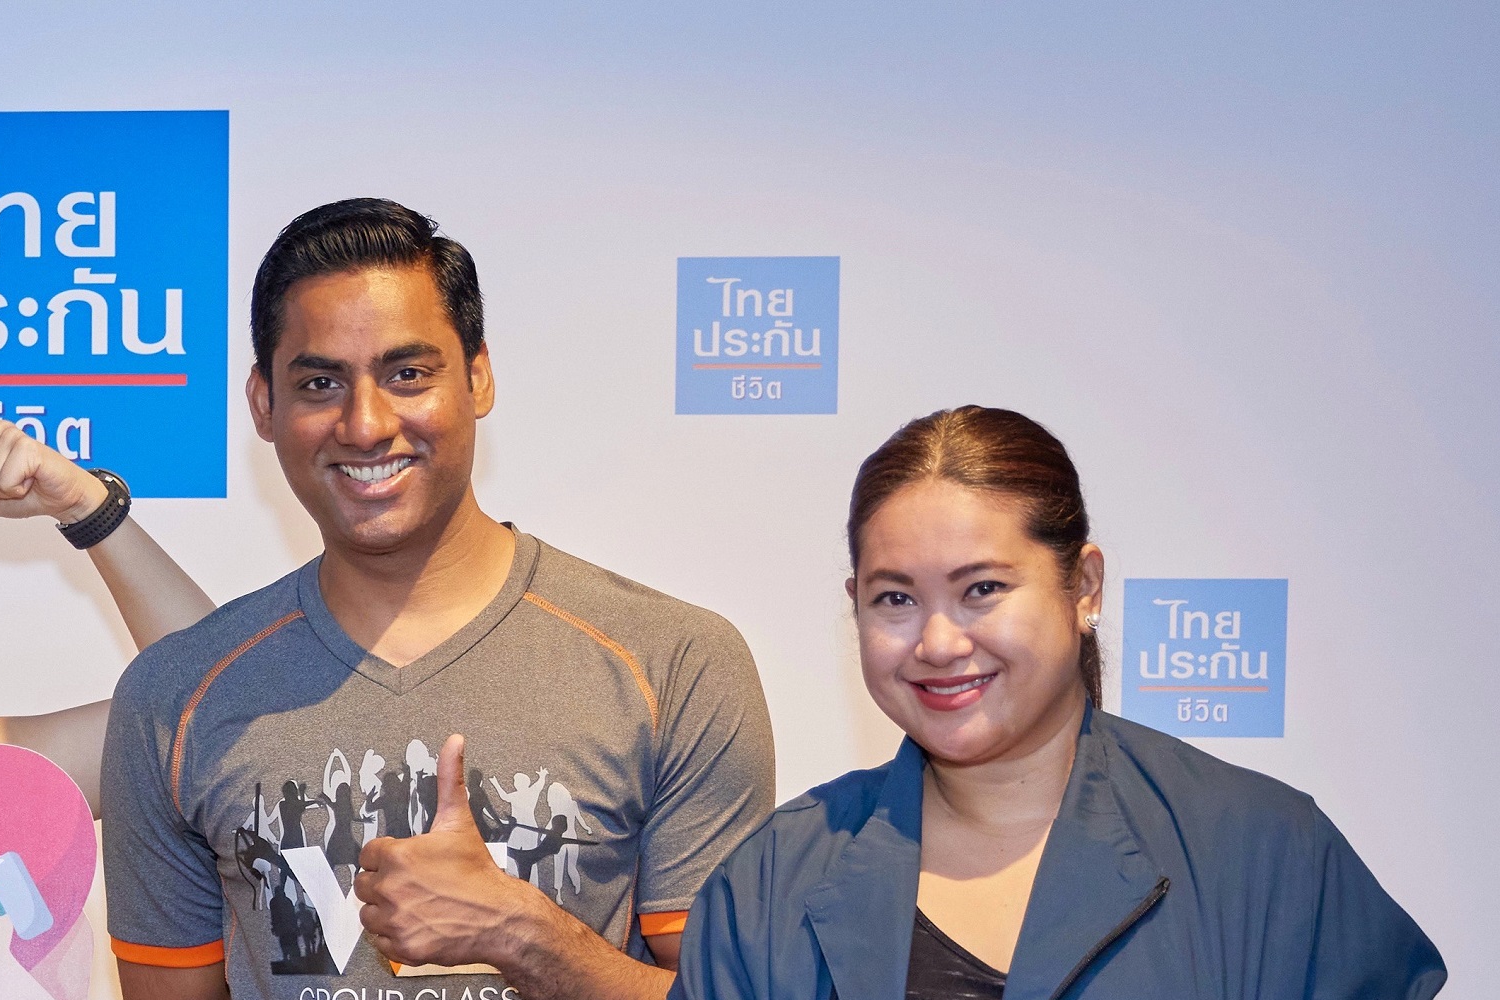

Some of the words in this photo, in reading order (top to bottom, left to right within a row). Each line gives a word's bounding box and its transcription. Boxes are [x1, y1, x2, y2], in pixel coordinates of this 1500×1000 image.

[705, 276, 794, 317] ไทย
[693, 320, 821, 357] ประกัน
[731, 374, 782, 400] ชีวิต
[1152, 598, 1241, 639] ไทย
[1139, 642, 1269, 680] ประกัน
[1177, 697, 1229, 722] ชีวิต
